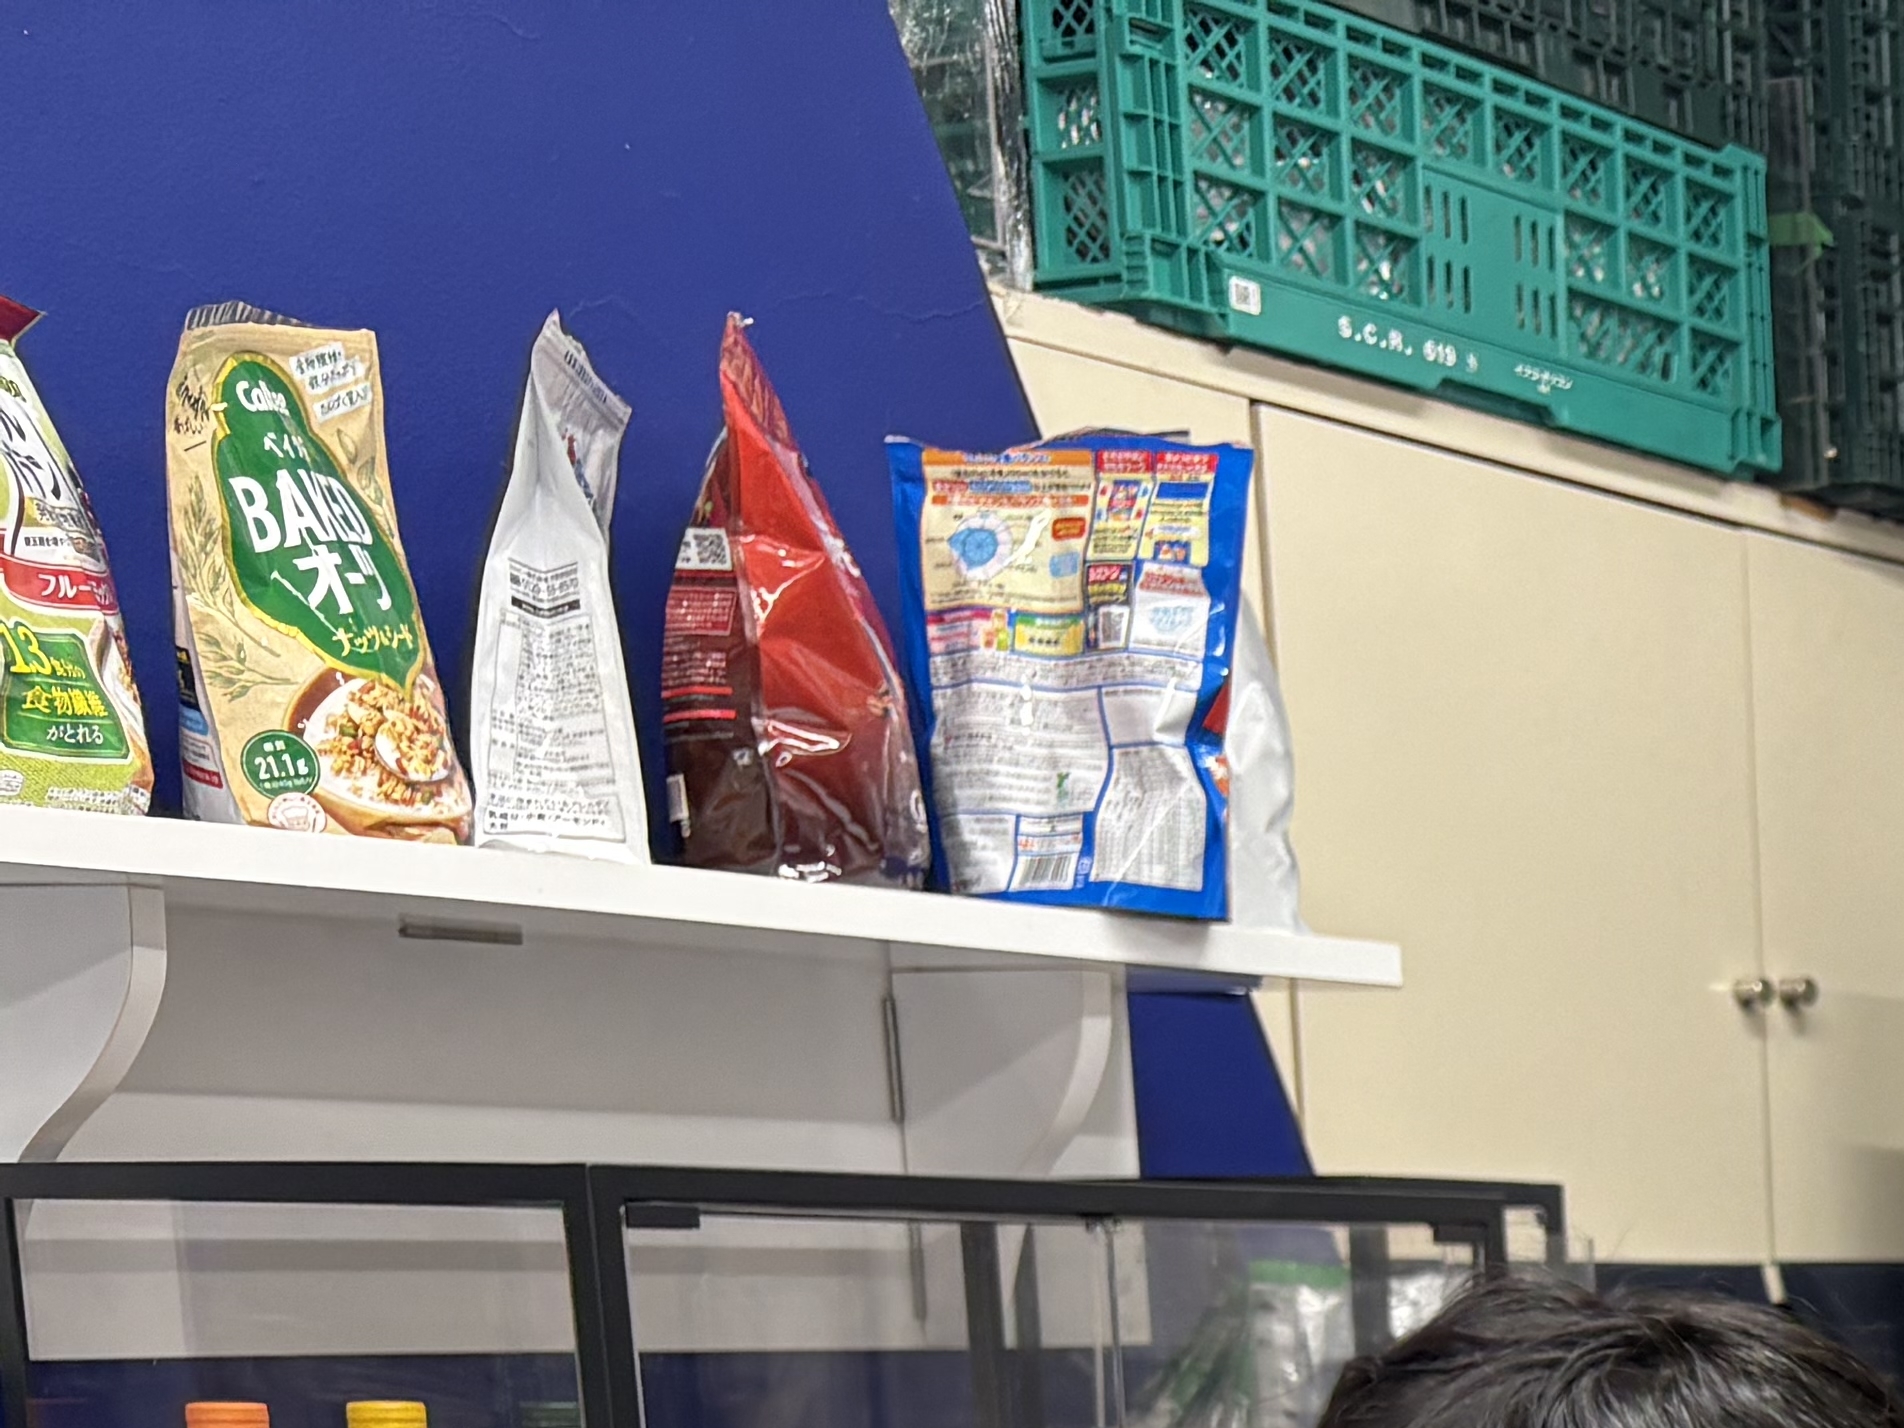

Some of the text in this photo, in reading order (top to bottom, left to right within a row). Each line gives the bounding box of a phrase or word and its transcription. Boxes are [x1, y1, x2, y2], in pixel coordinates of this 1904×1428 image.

[228, 468, 374, 553] BAKED
[292, 543, 393, 615] オーツ
[46, 723, 105, 745] がとれる
